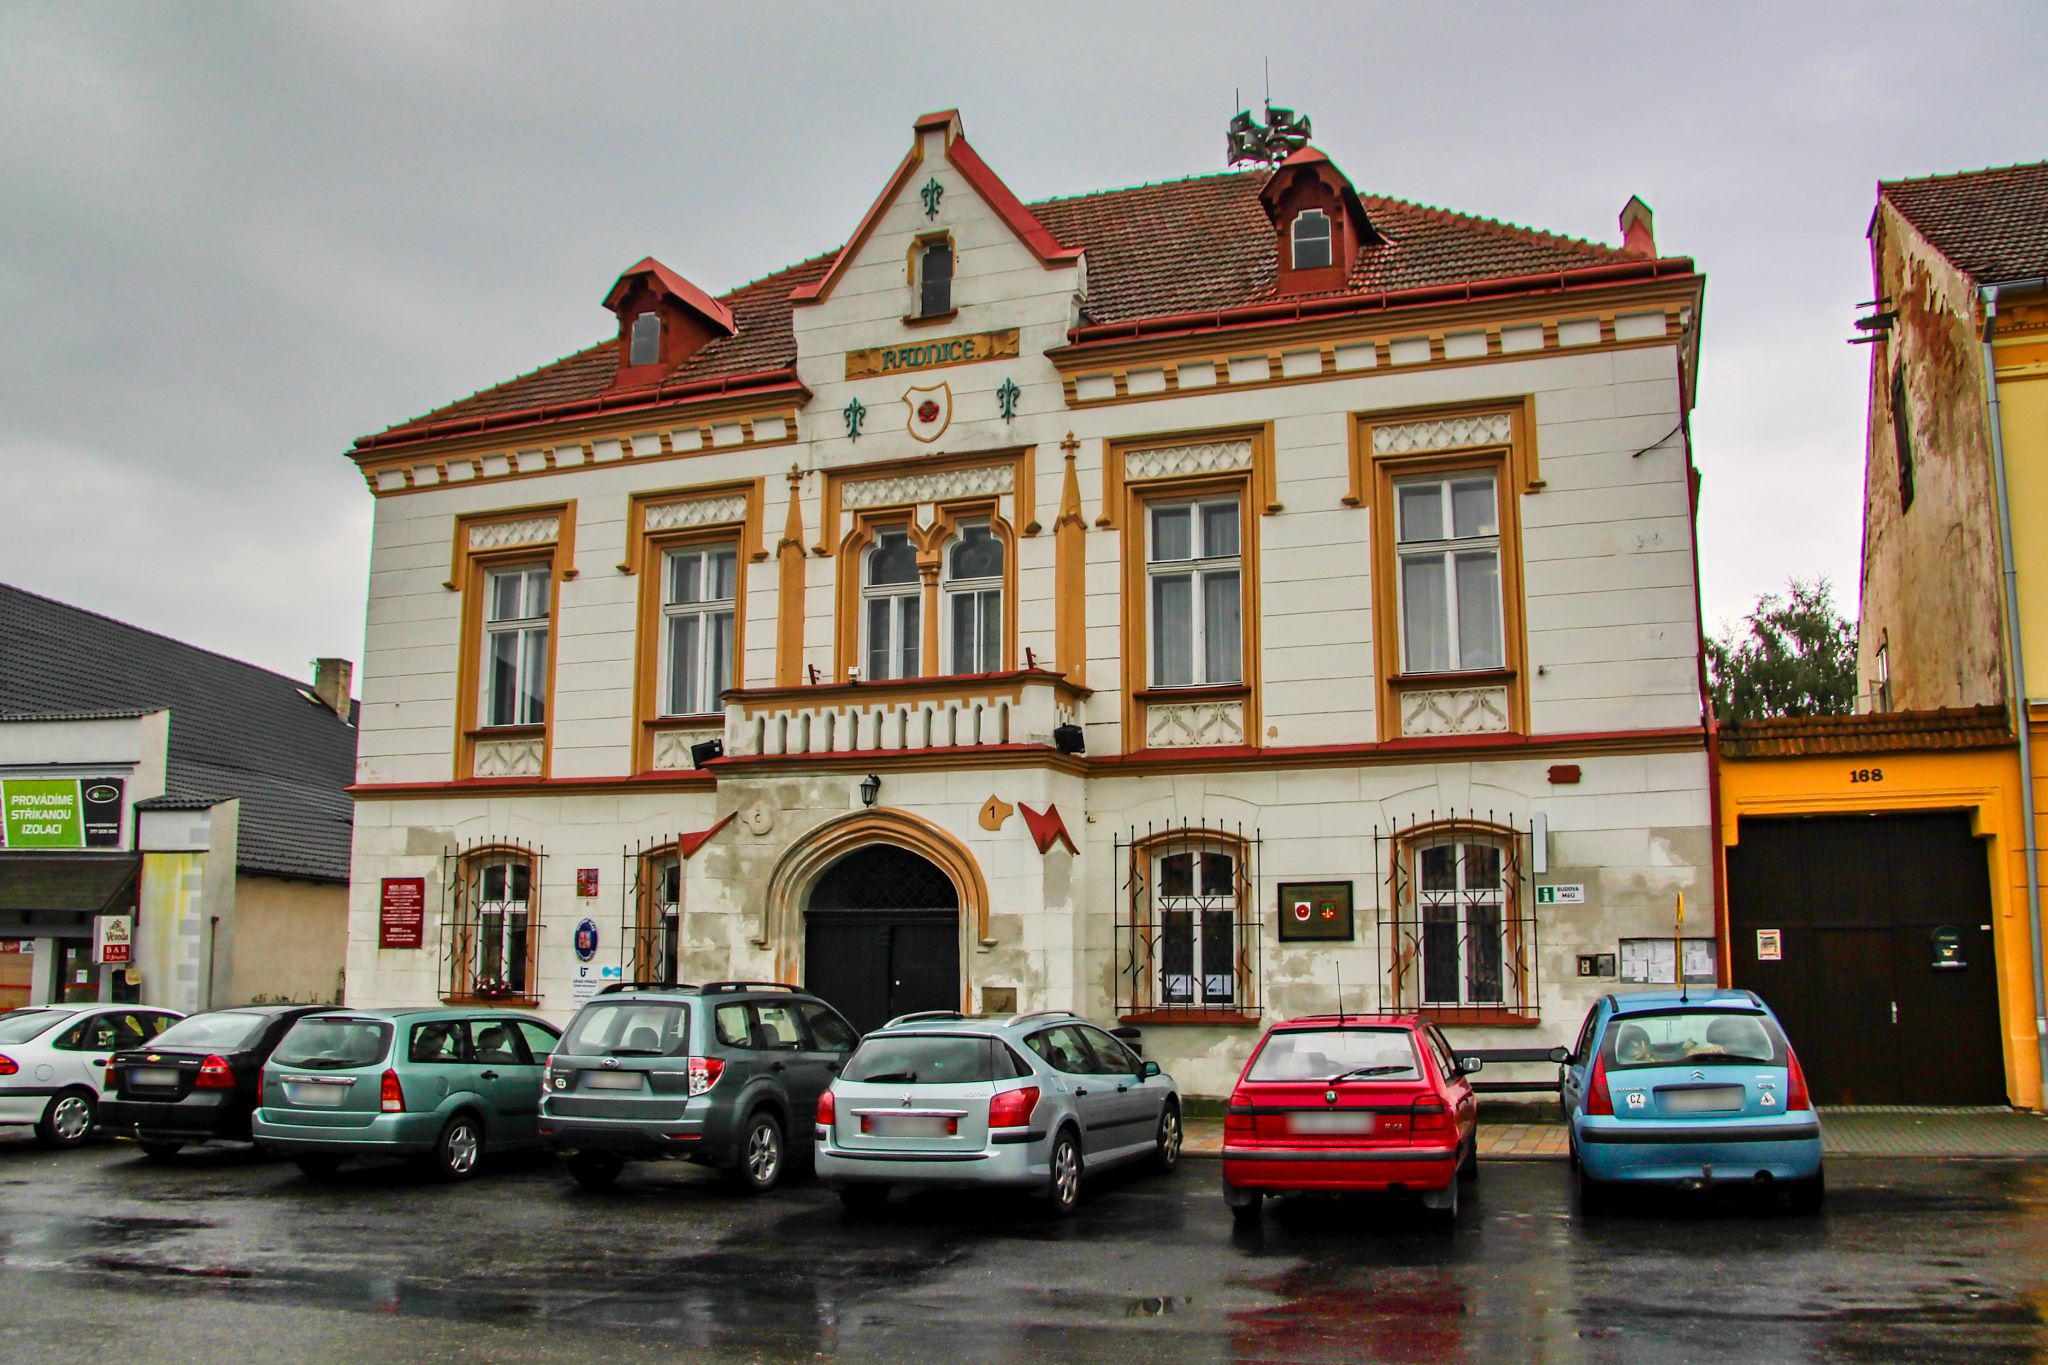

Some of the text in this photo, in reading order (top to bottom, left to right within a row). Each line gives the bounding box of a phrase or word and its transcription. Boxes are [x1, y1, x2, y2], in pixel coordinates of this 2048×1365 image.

[1850, 768, 1883, 783] 168
[11, 793, 73, 805] PROVÁDÍME
[11, 807, 71, 820] STŘÍKANOU
[989, 805, 995, 819] 1
[22, 824, 62, 835] IZOLACI
[106, 946, 127, 954] BAR
[1630, 1094, 1641, 1104] CZ
